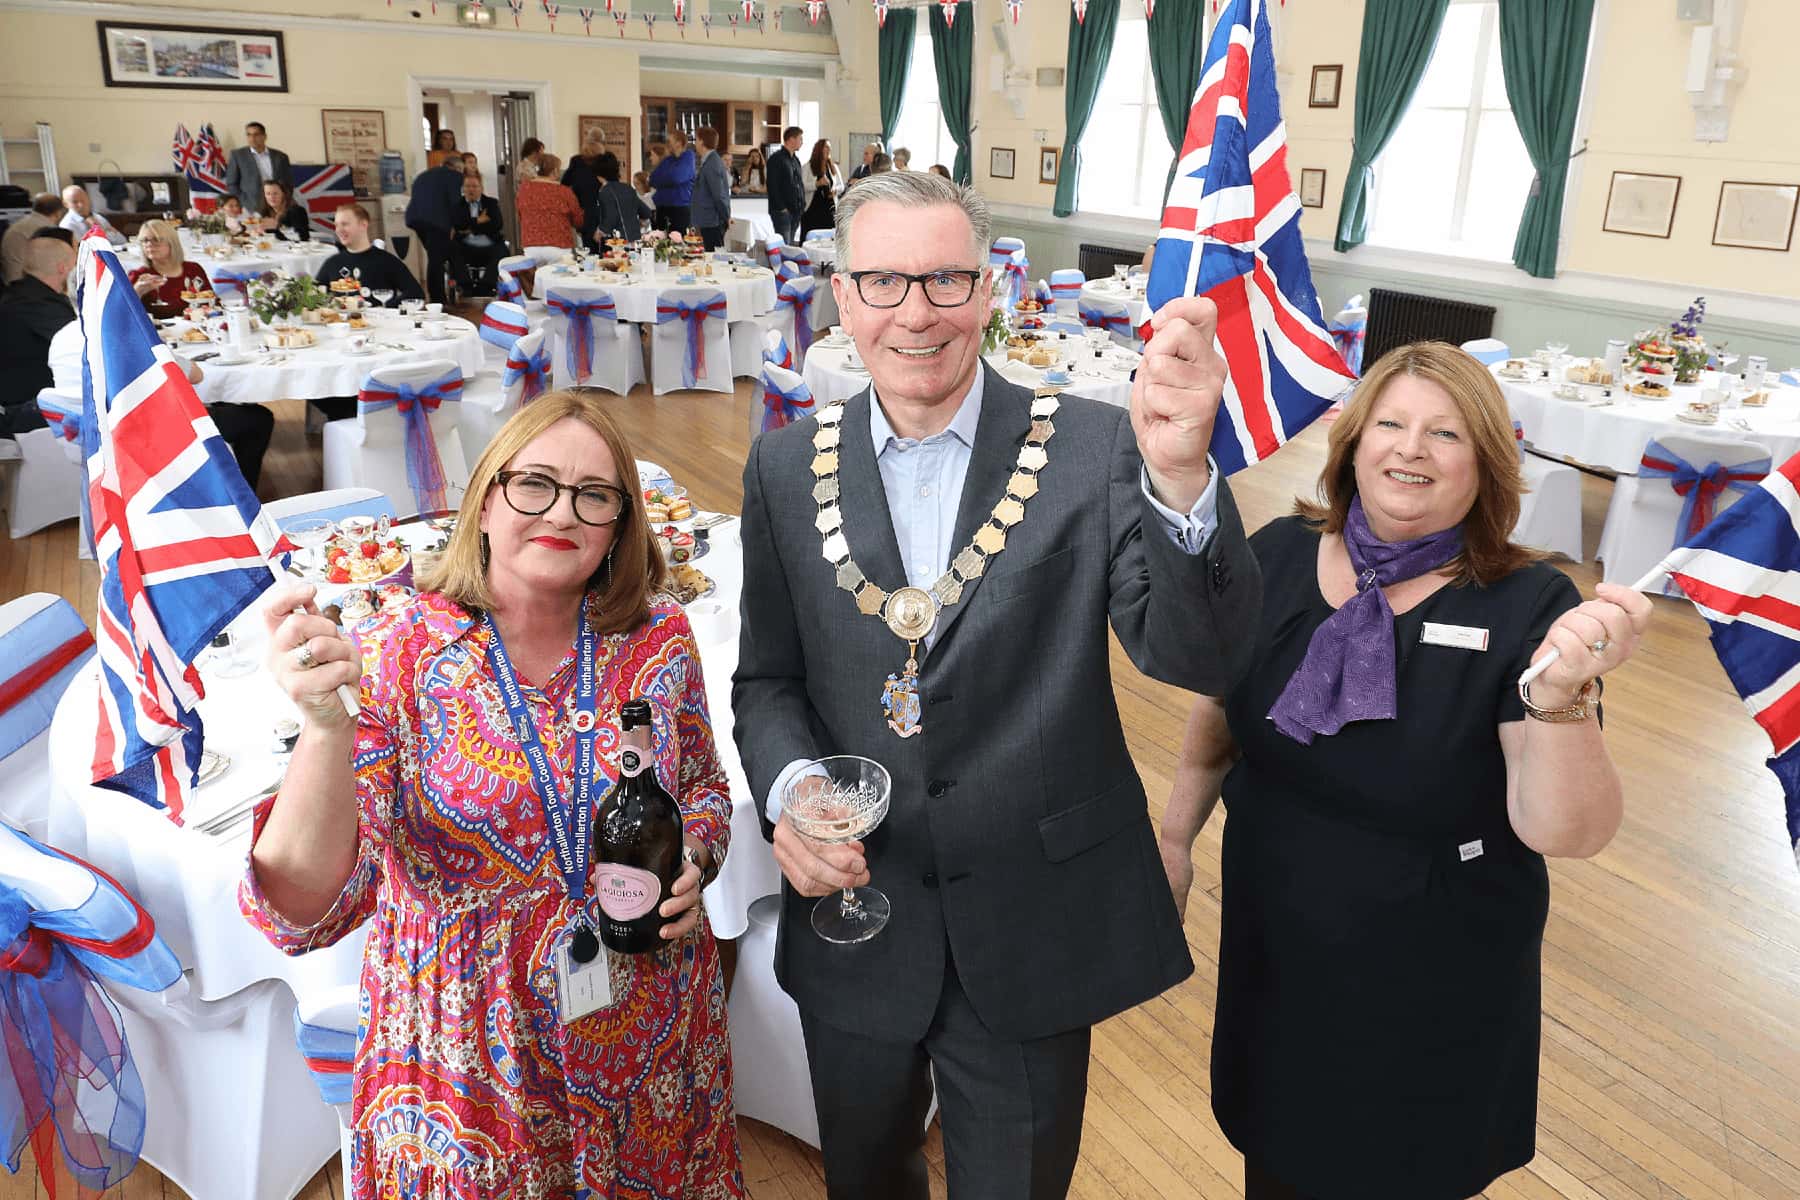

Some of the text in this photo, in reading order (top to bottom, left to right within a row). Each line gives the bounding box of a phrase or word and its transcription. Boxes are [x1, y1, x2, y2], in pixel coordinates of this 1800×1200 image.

[494, 648, 521, 709] Northallerton
[581, 639, 592, 697] Northallerton
[578, 738, 591, 776] Council
[528, 746, 574, 874] Northallerton Town Council
[577, 778, 589, 804] Town
